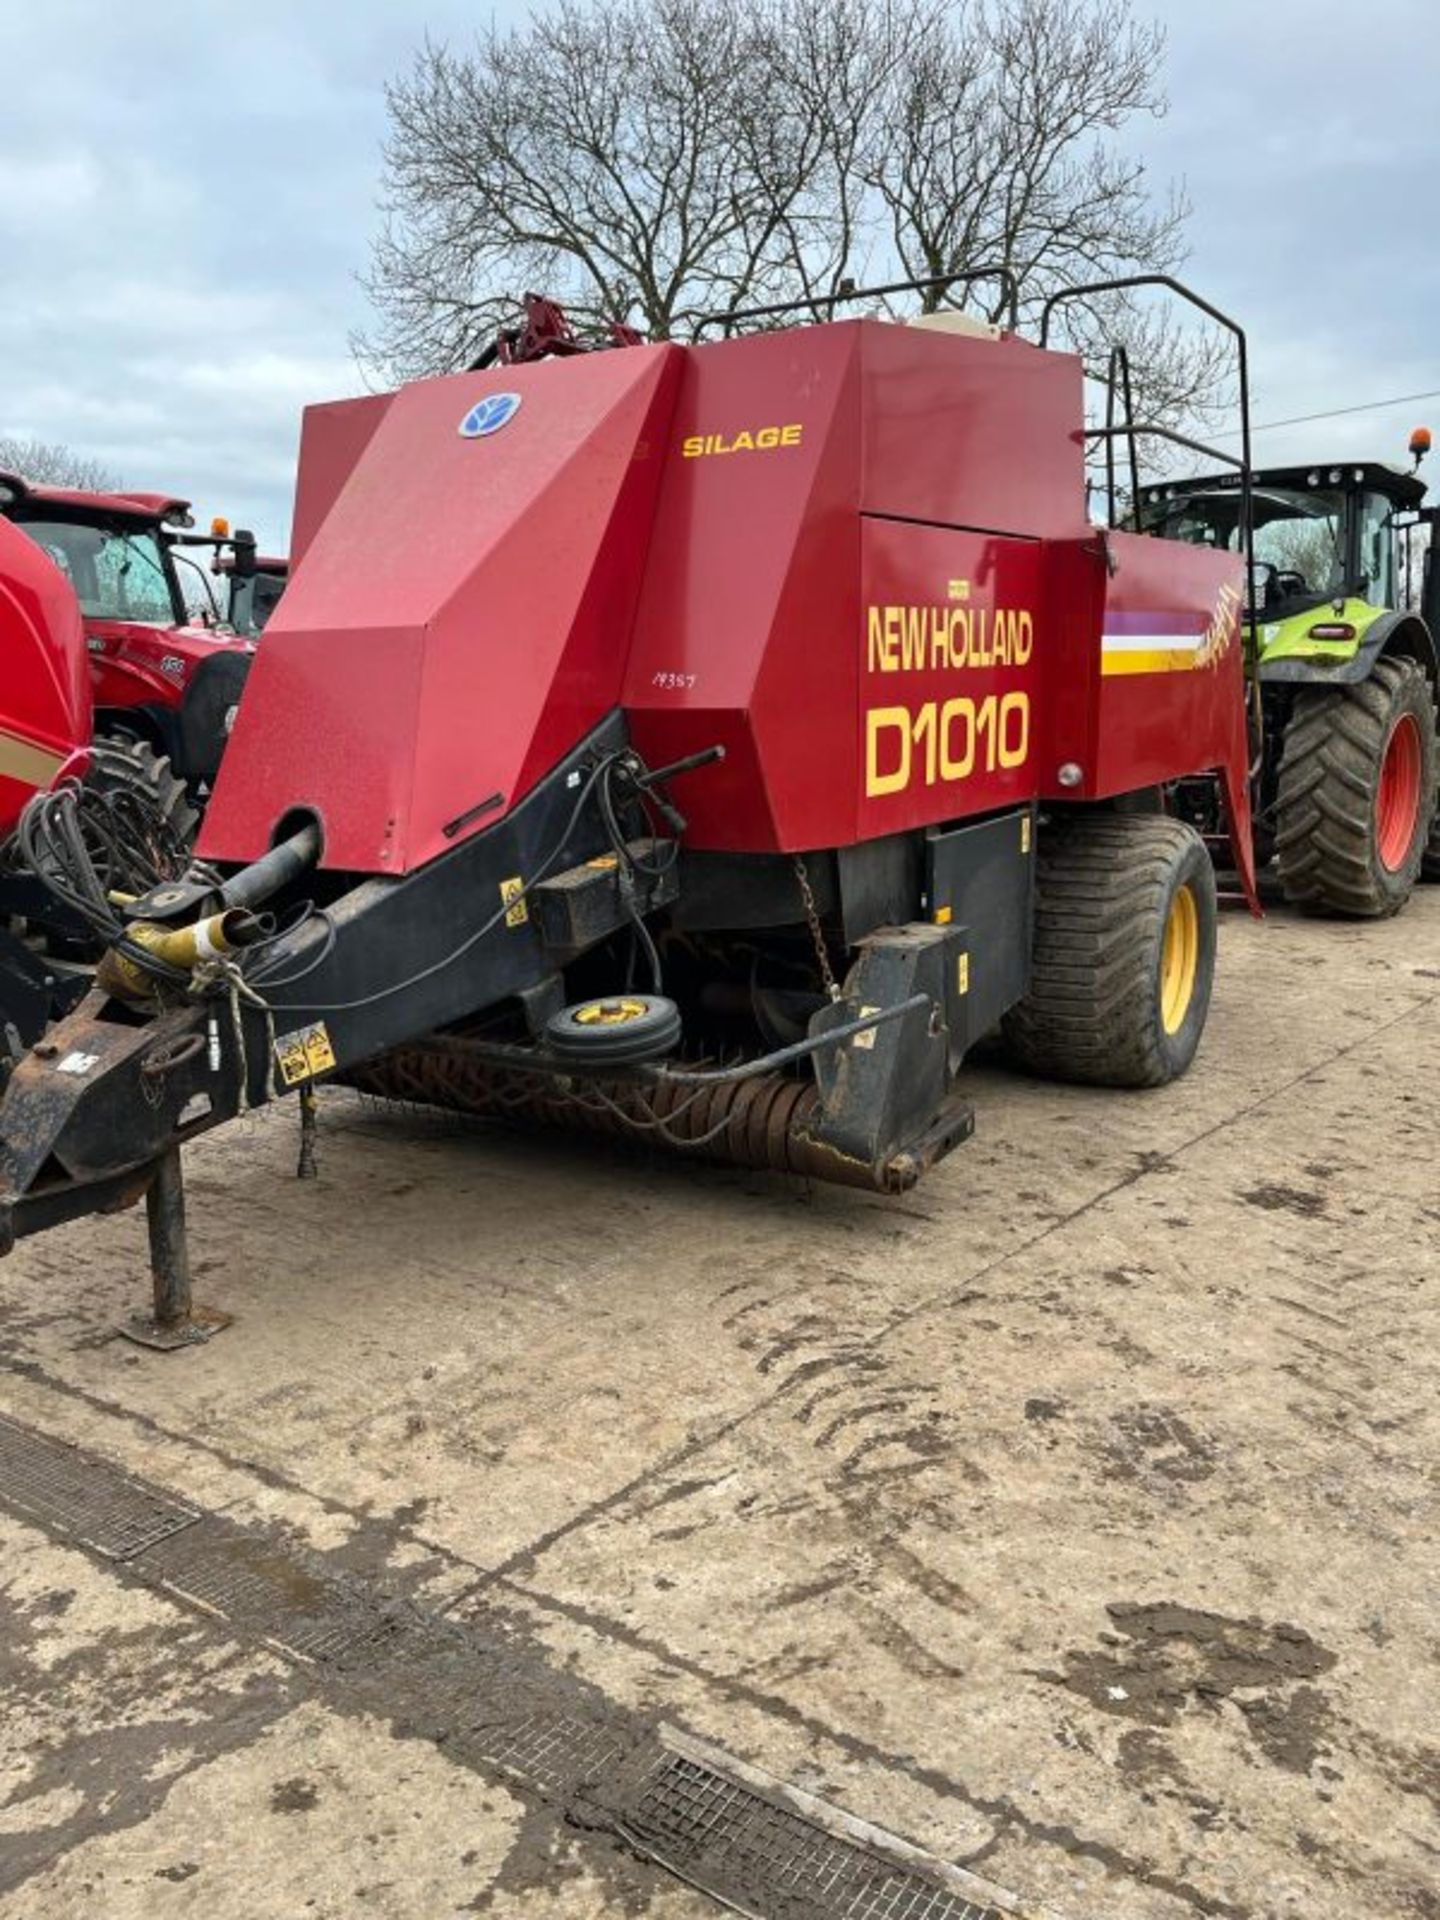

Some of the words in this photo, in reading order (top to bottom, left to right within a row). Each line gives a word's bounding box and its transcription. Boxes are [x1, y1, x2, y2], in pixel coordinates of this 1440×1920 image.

[682, 424, 803, 457] SILAGE
[867, 607, 928, 672] NEW
[931, 608, 1033, 669] HOLLAND
[866, 691, 1030, 798] D1010
